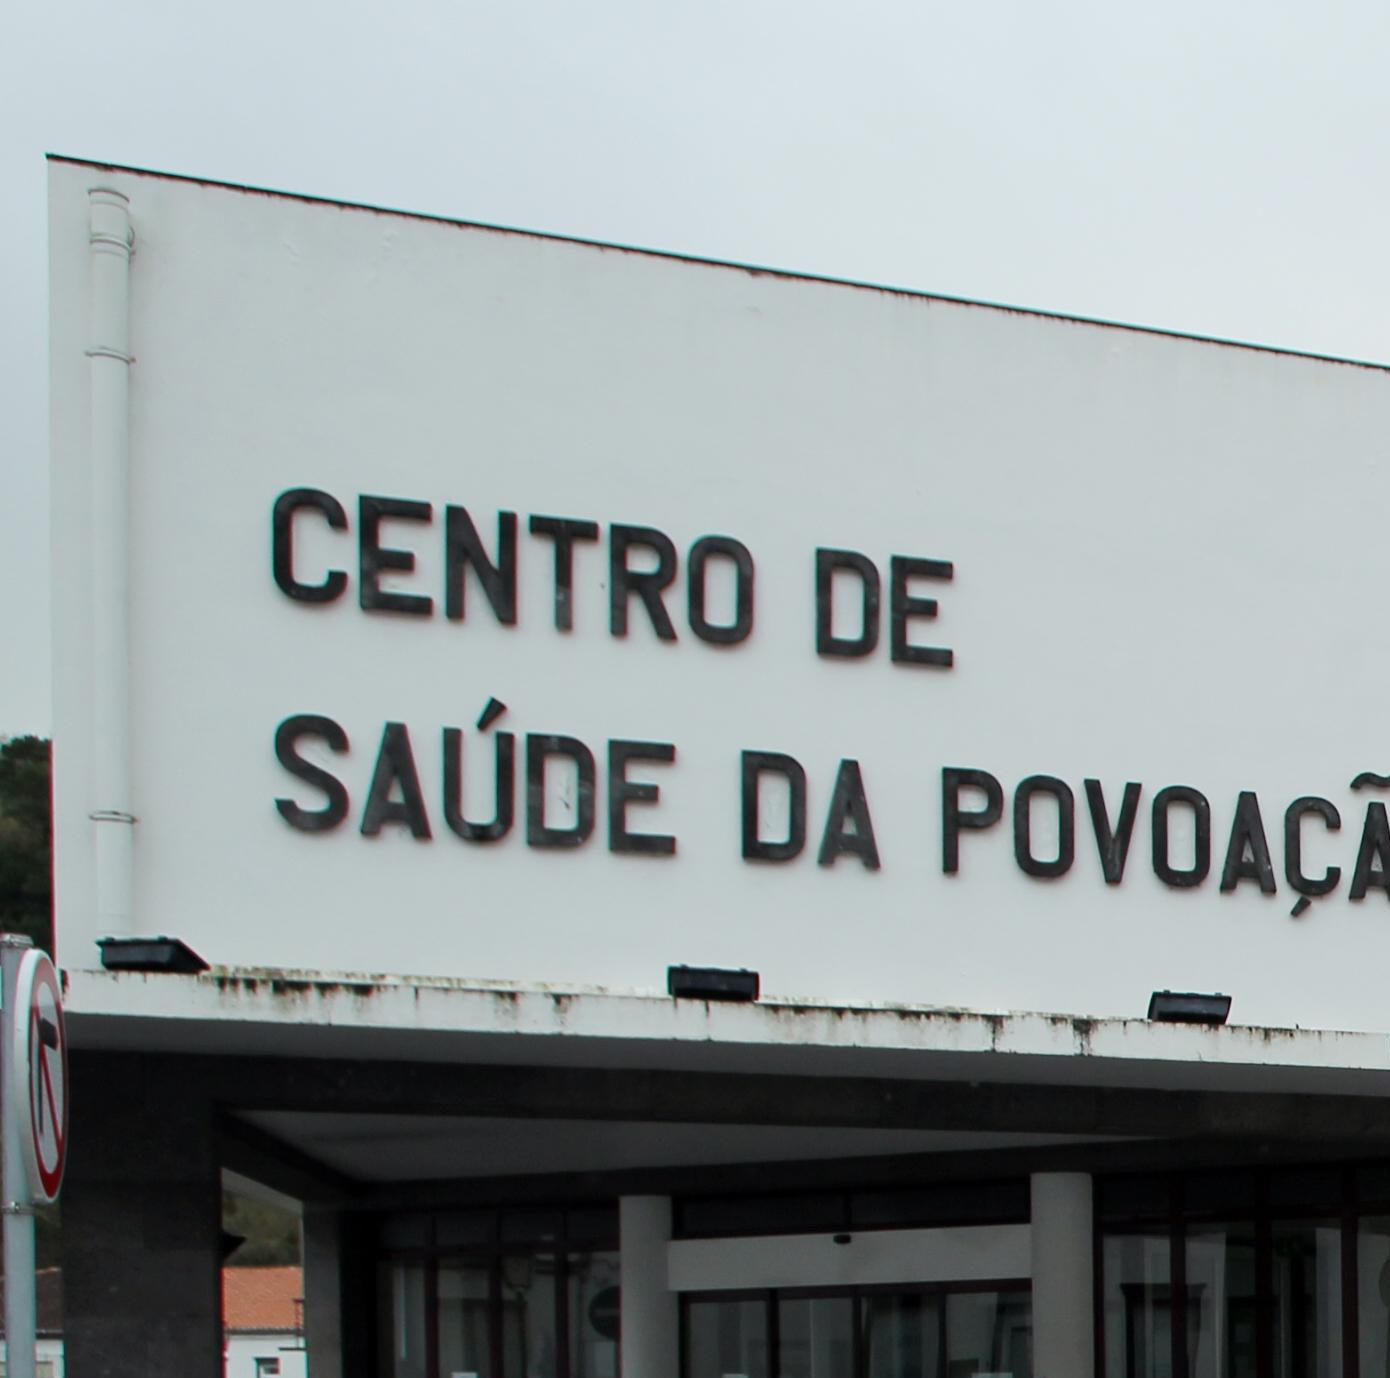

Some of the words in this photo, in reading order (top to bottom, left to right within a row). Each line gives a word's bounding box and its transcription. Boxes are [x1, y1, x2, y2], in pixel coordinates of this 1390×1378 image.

[272, 488, 754, 645] CENTRO
[816, 547, 954, 668] DE
[274, 697, 676, 855] SAÚDE
[741, 750, 880, 870] DA
